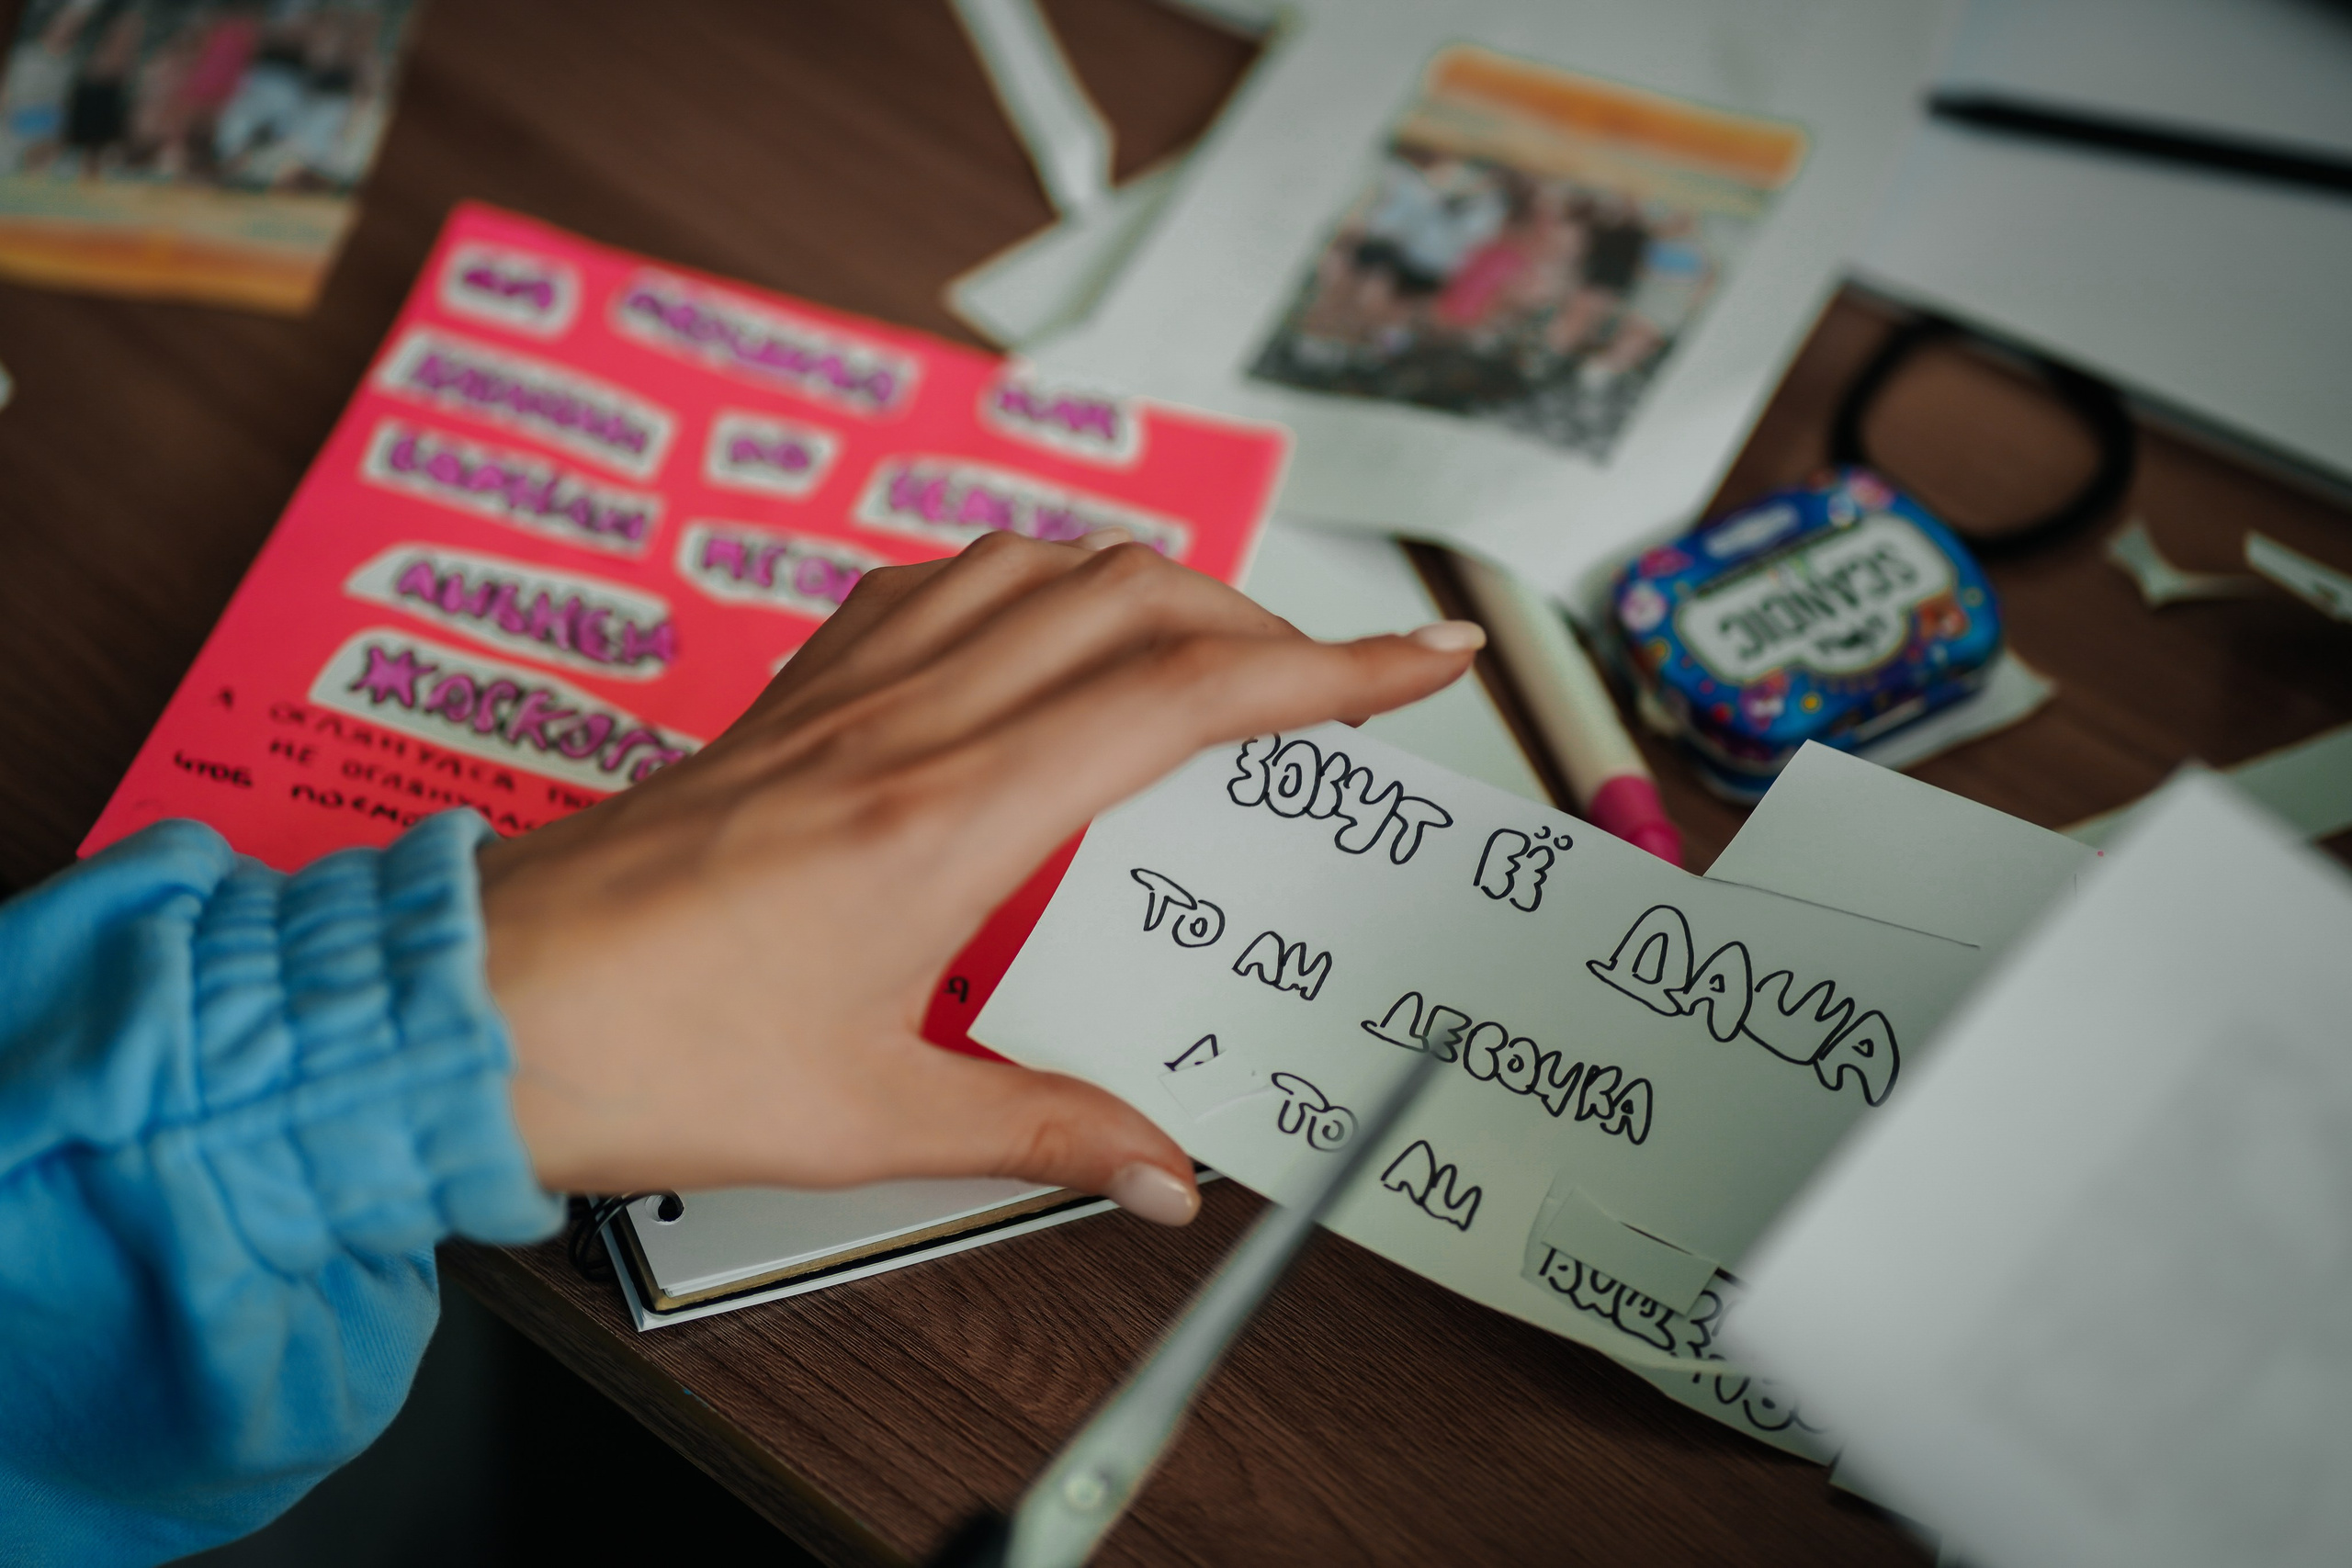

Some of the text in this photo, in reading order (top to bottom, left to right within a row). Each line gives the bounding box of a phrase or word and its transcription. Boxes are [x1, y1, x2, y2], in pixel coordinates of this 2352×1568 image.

[1714, 546, 1917, 660] SCANDIC
[1130, 868, 1226, 948] ТО
[1361, 991, 1654, 1146] ДЕВОЧКА
[1227, 732, 1453, 865] ЗОВУТ
[1585, 904, 1901, 1108] ДАША
[1272, 1072, 1359, 1152] ТО
